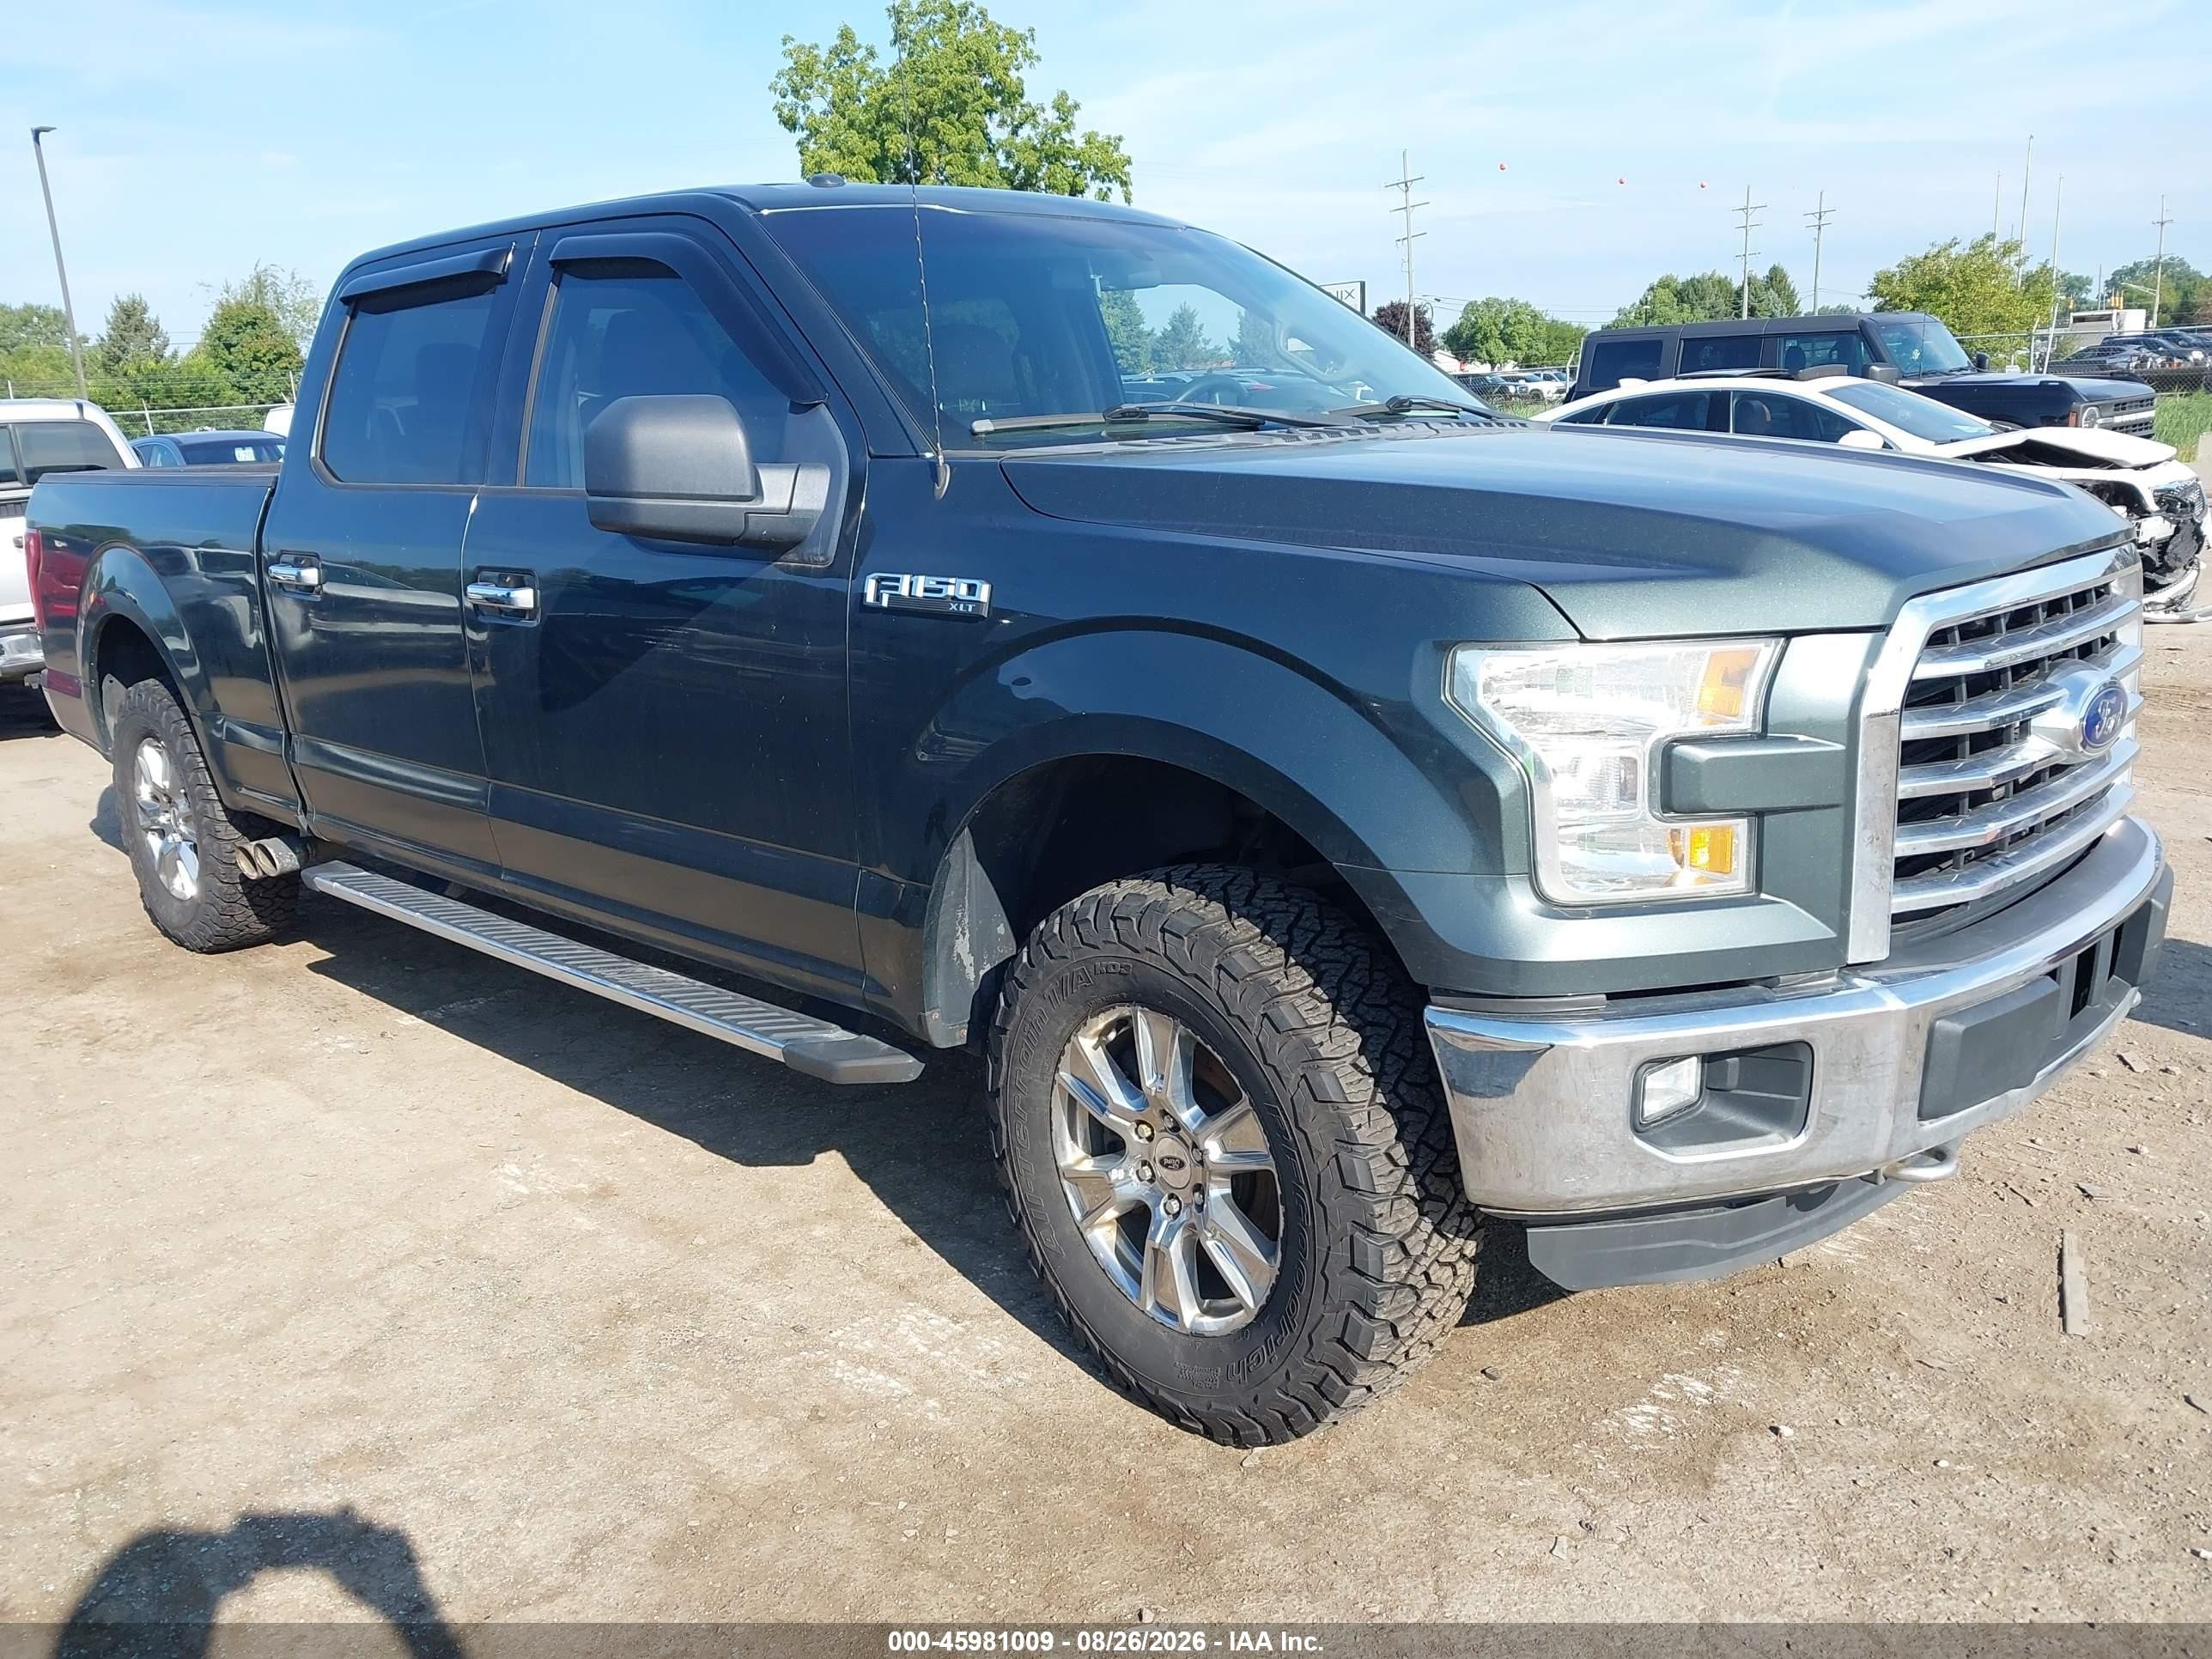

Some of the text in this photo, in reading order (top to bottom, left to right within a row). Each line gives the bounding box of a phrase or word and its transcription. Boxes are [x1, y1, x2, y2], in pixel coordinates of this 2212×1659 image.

[948, 602, 976, 612] XLT
[2094, 696, 2124, 740] Ford
[1042, 966, 1094, 1012] T/A
[1163, 1157, 1182, 1170] Ford
